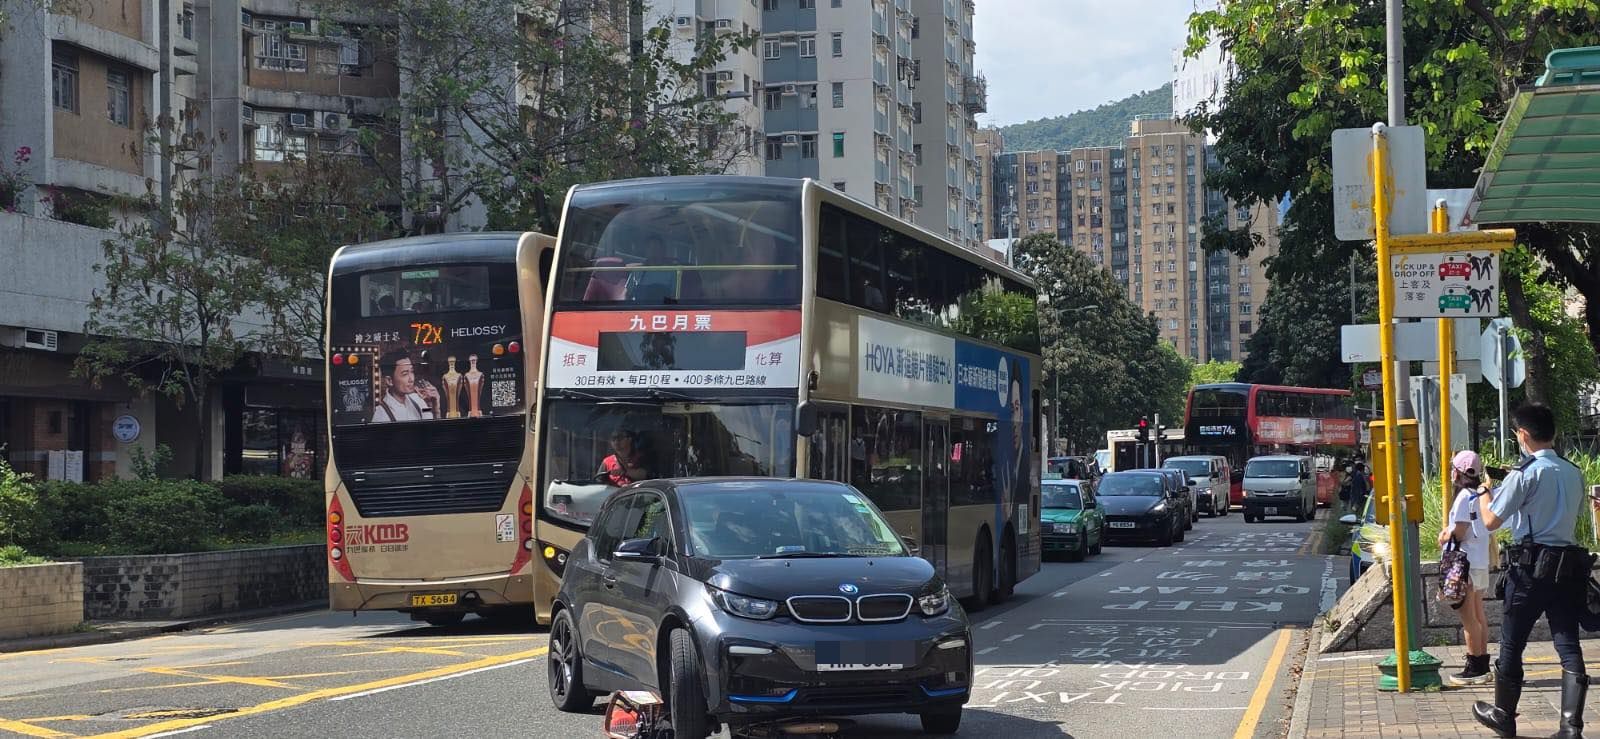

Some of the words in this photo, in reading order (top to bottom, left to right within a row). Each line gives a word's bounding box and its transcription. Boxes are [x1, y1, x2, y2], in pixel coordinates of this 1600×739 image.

[1399, 280, 1431, 289] 上客及
[630, 314, 712, 331] 九巴月票
[451, 325, 507, 338] HELIOSSY
[755, 352, 782, 366] 化算
[865, 342, 895, 374] HOYA
[338, 378, 369, 386] HELIOSSY
[364, 523, 410, 544] KMB
[413, 596, 426, 605] TX
[430, 594, 456, 605] 5684
[1102, 600, 1283, 611] KEEP
[1099, 670, 1250, 681] DROP
[1089, 680, 1224, 693] PICK
[989, 690, 1126, 705] TAXI
